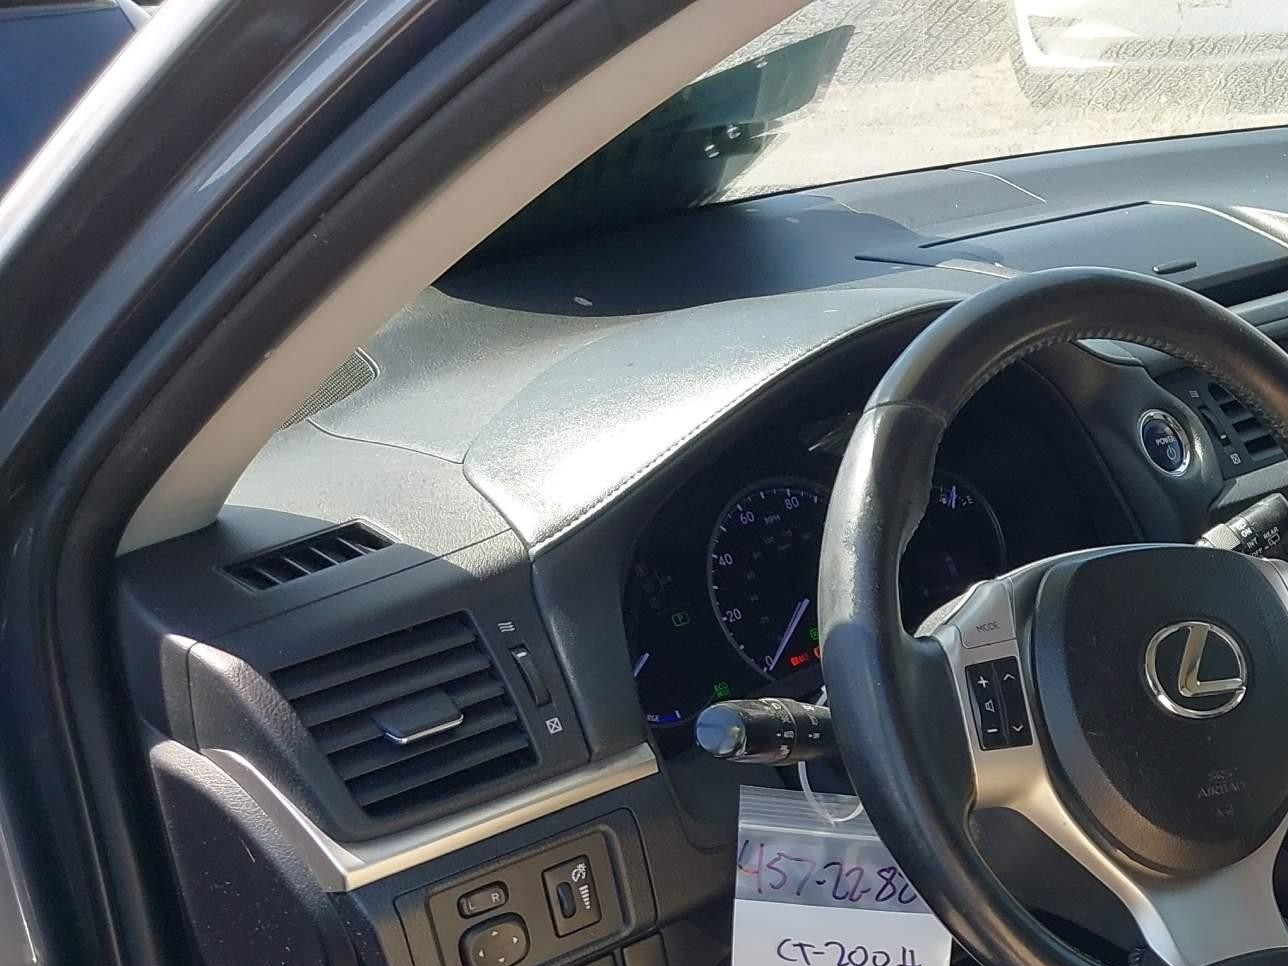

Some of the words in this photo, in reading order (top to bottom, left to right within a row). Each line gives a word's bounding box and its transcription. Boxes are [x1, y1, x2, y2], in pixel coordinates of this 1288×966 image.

[1155, 435, 1178, 446] POWER
[784, 498, 800, 510] 80
[739, 511, 755, 524] 60
[764, 513, 781, 524] MPH
[718, 552, 734, 567] 40
[726, 608, 742, 624] 20
[976, 621, 1001, 633] MODE
[491, 892, 500, 903] R
